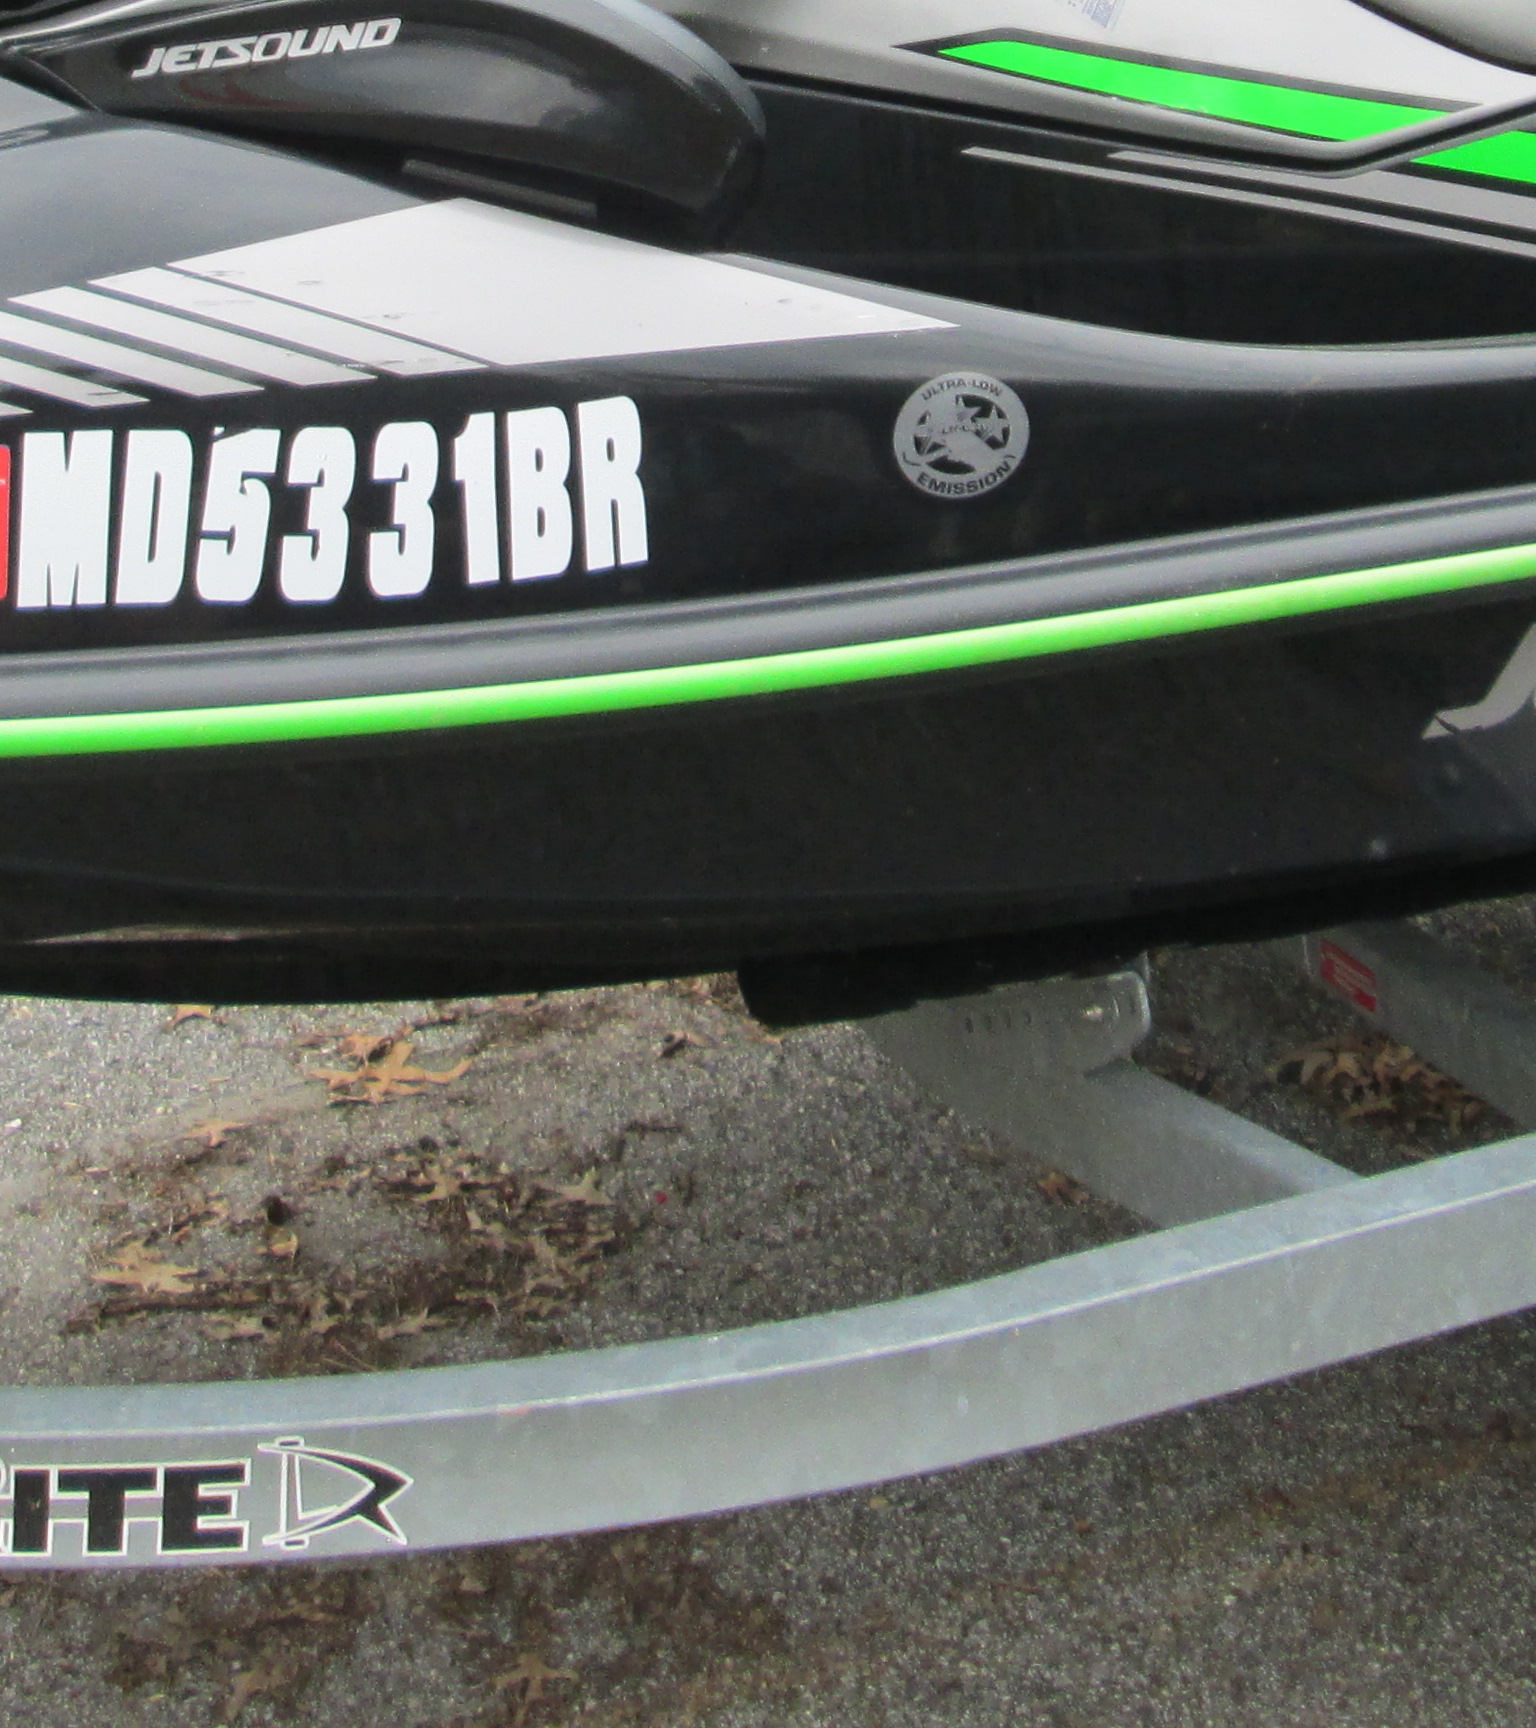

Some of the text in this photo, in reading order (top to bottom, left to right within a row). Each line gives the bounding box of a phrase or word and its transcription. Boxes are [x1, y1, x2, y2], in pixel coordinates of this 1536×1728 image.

[131, 17, 402, 78] JETSOUND
[16, 396, 649, 609] MD5331BR
[916, 461, 1012, 495] EMISSION
